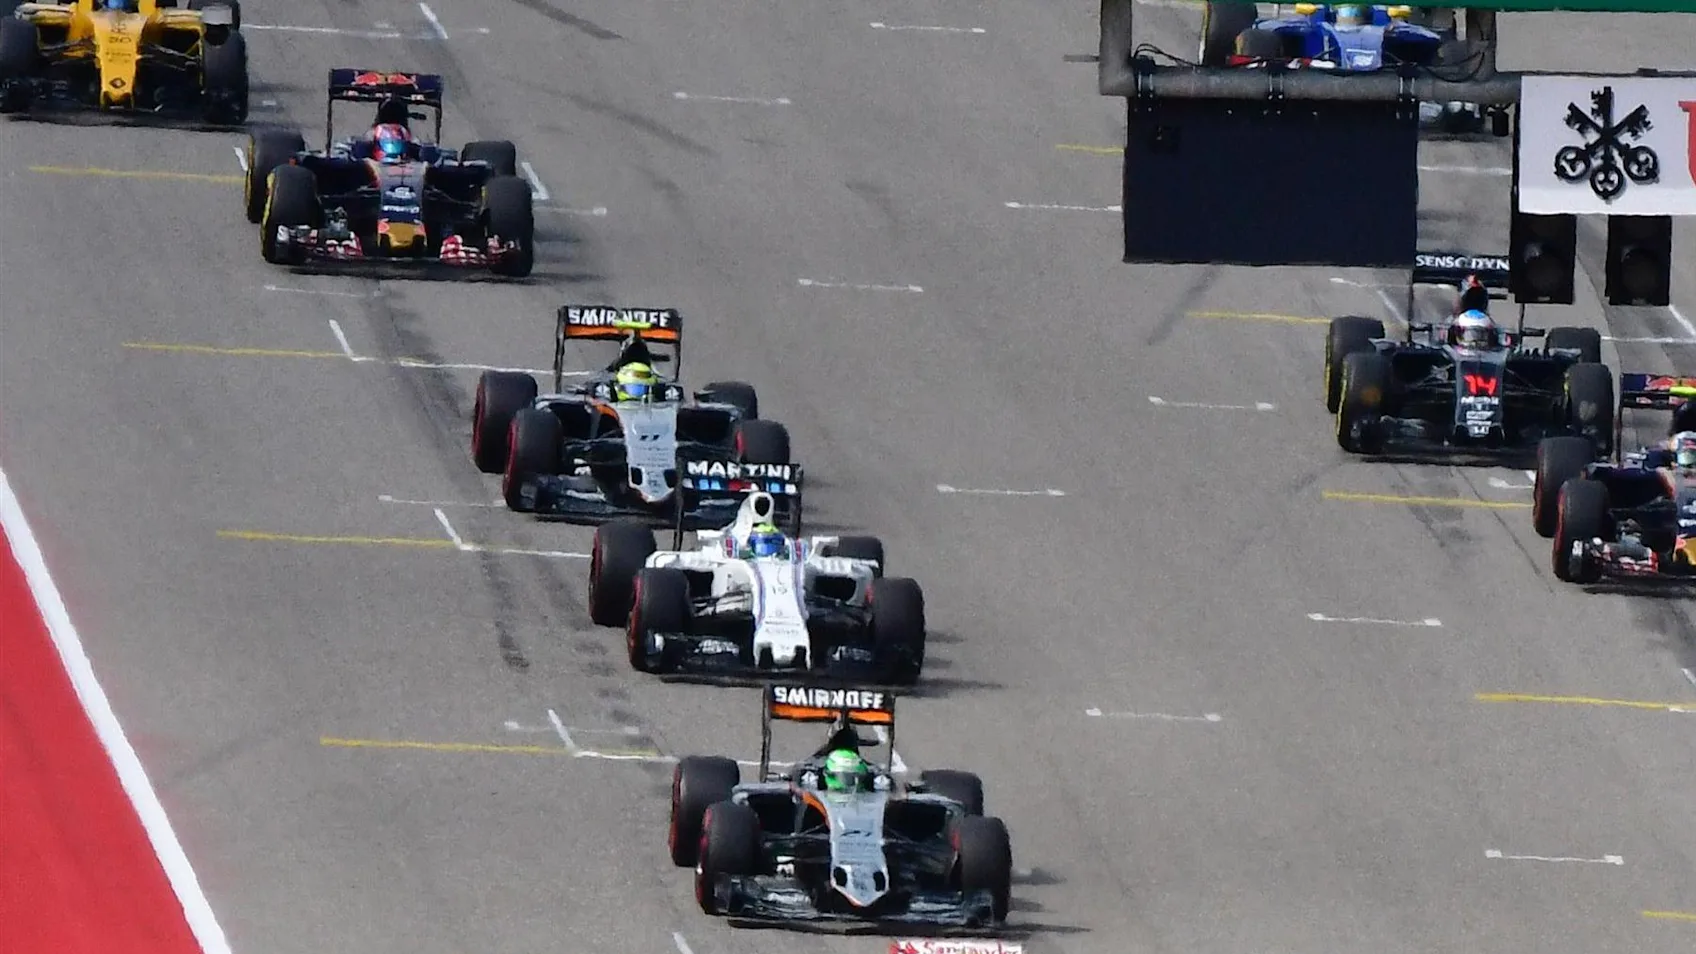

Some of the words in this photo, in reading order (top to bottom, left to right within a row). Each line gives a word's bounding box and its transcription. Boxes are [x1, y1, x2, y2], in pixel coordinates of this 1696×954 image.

[1463, 374, 1497, 396] 14
[687, 461, 791, 479] MARTINI
[774, 687, 885, 709] SMIRNOFF
